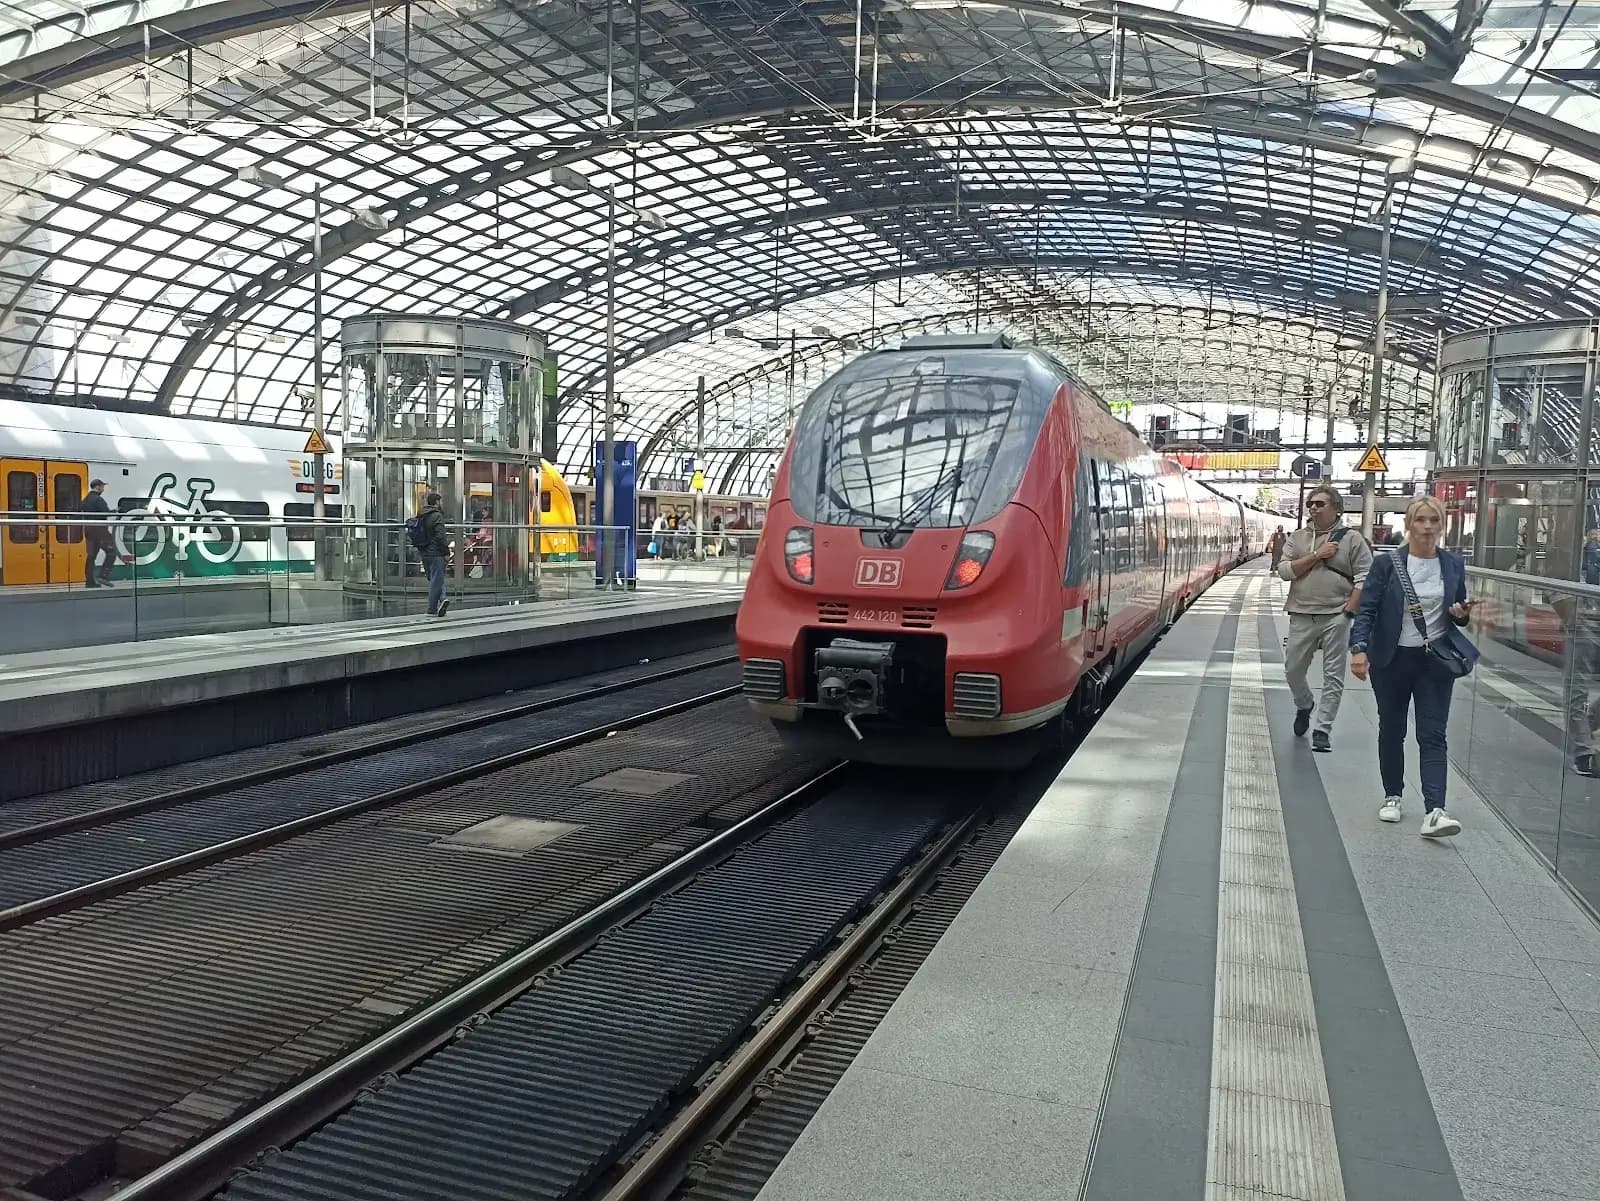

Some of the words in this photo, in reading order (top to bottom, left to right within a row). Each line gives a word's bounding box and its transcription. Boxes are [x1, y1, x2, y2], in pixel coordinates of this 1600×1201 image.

[302, 460, 334, 479] OG
[1305, 462, 1314, 475] F
[860, 561, 897, 583] DB
[853, 609, 875, 621] 442
[878, 610, 897, 622] 120
